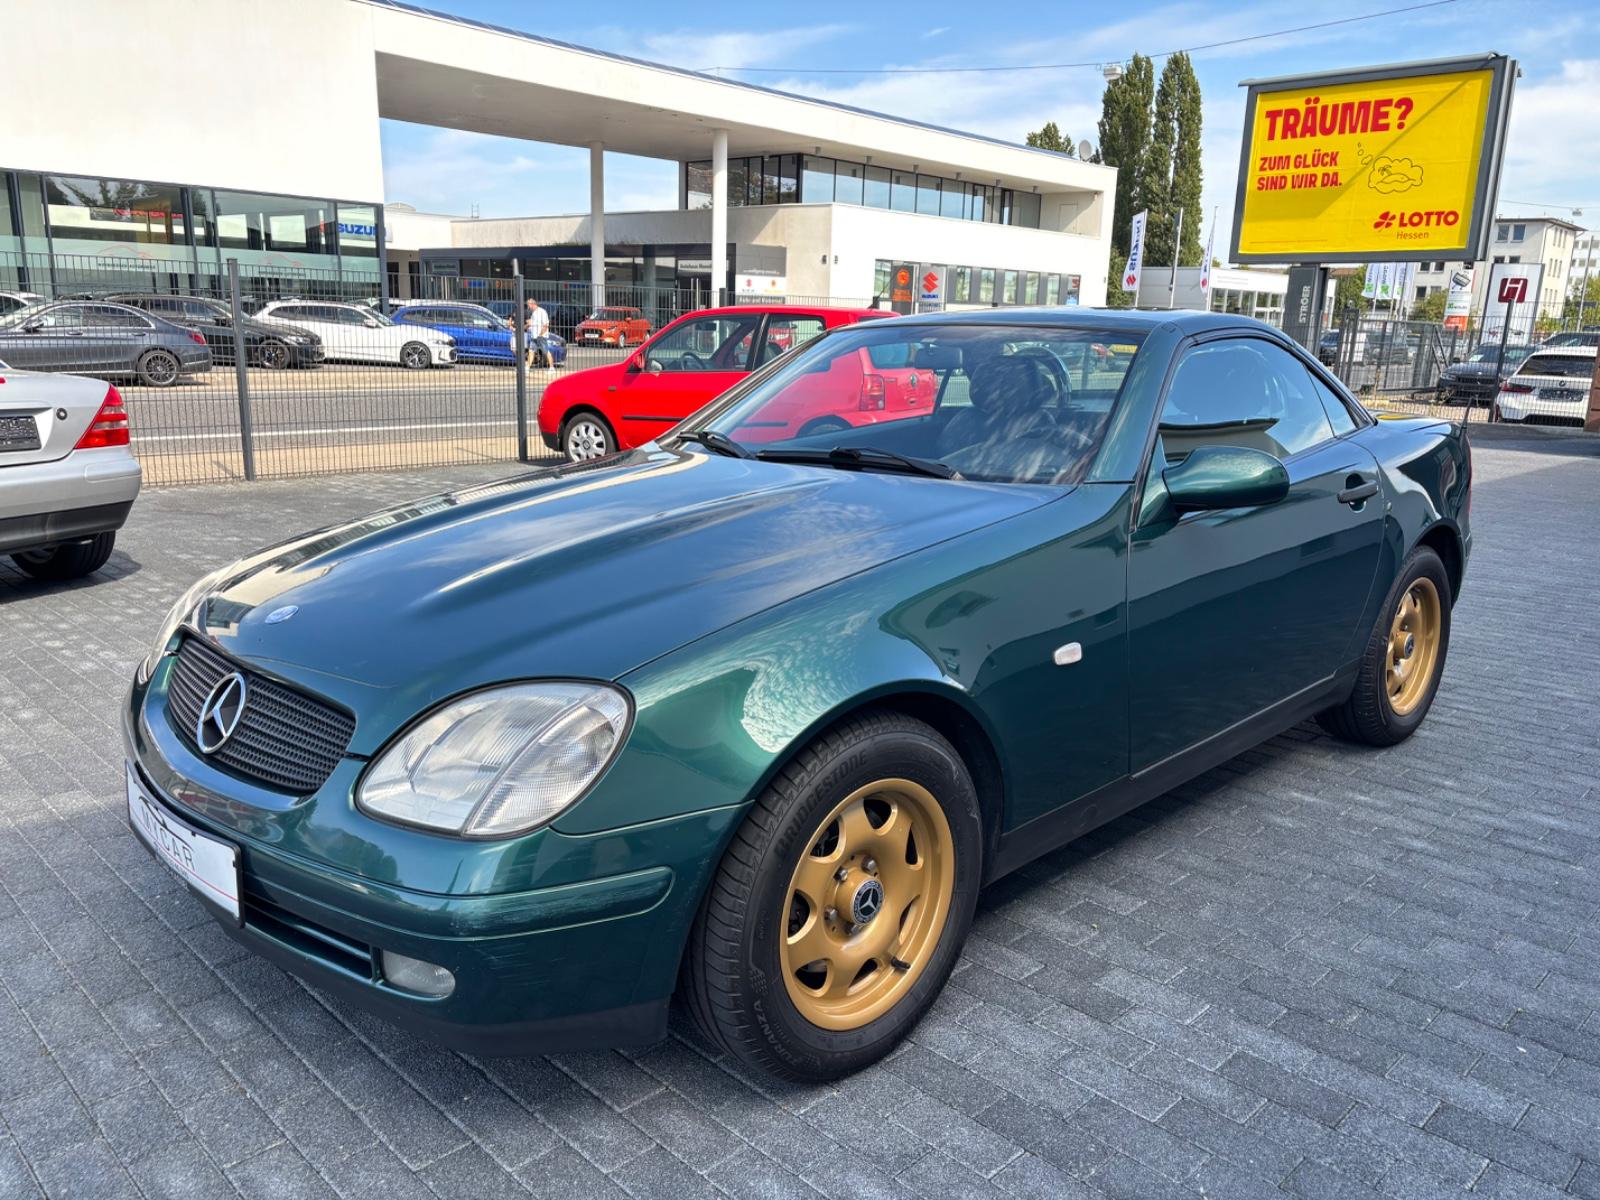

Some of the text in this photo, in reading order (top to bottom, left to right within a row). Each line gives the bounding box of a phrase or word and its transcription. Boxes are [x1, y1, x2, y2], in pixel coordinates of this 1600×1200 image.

[1265, 96, 1414, 141] TRÄUME?
[1259, 149, 1339, 172] ZUM GLÜCK
[1257, 172, 1342, 191] SIND WIR DA.
[1398, 210, 1460, 228] LOTTO
[1396, 231, 1429, 240] Hessen
[774, 749, 868, 858] BRIDGESTONE
[753, 999, 799, 1066] TURANZA
